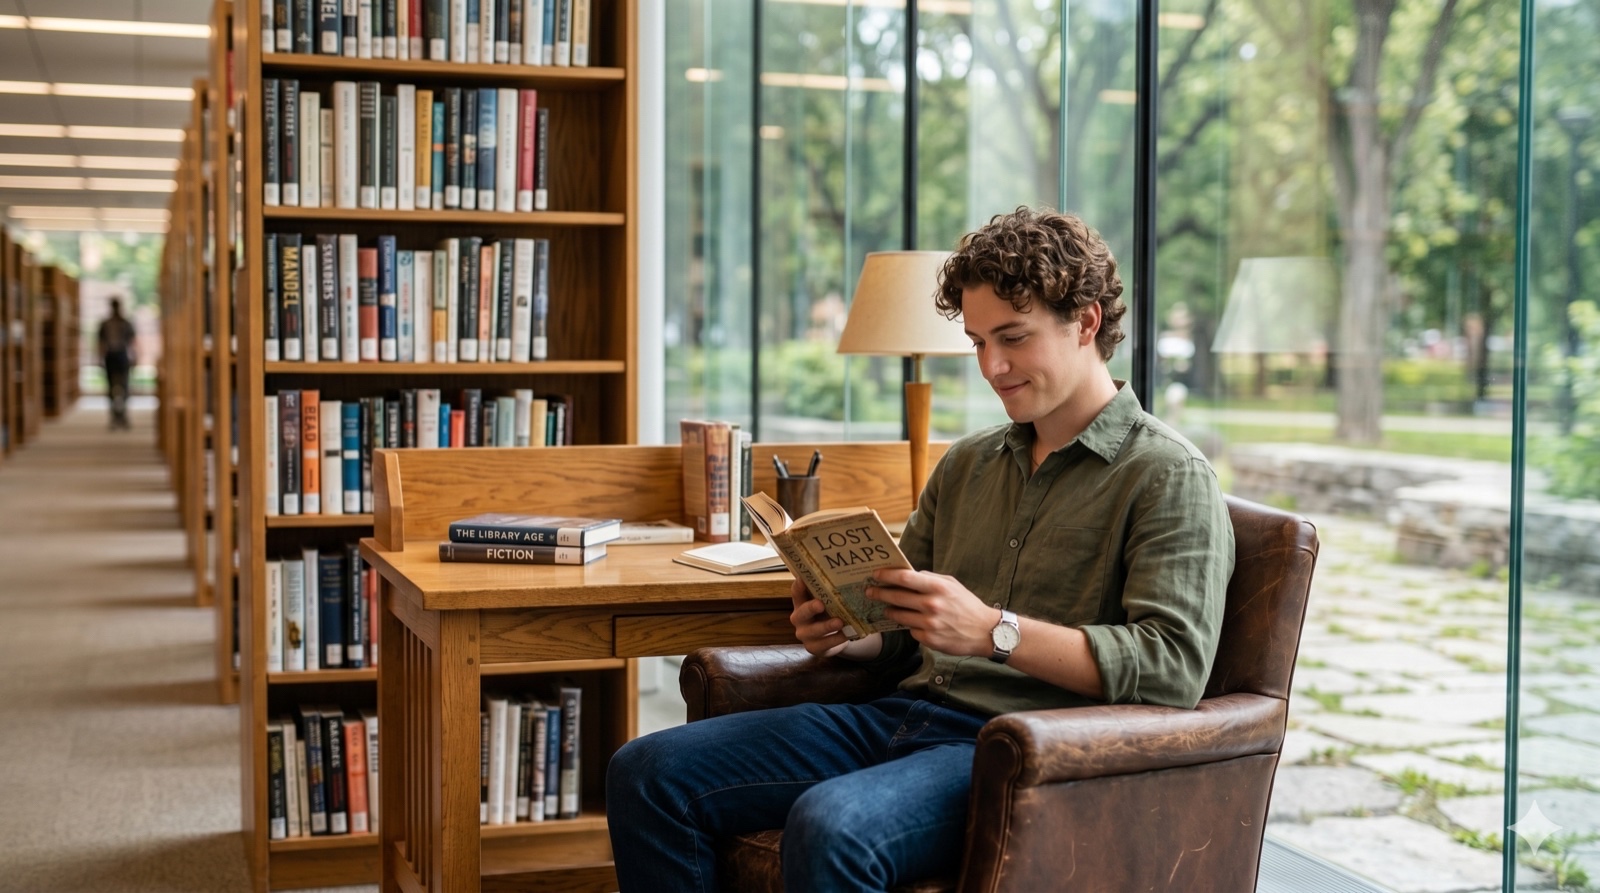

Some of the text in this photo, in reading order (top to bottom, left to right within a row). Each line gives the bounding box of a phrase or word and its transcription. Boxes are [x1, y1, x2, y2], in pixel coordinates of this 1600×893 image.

[282, 245, 300, 310] MANDEL
[455, 528, 544, 542] THE LIBRARY AGE
[812, 526, 874, 552] LOST
[486, 548, 534, 560] FICTION
[824, 544, 890, 569] MAPS
